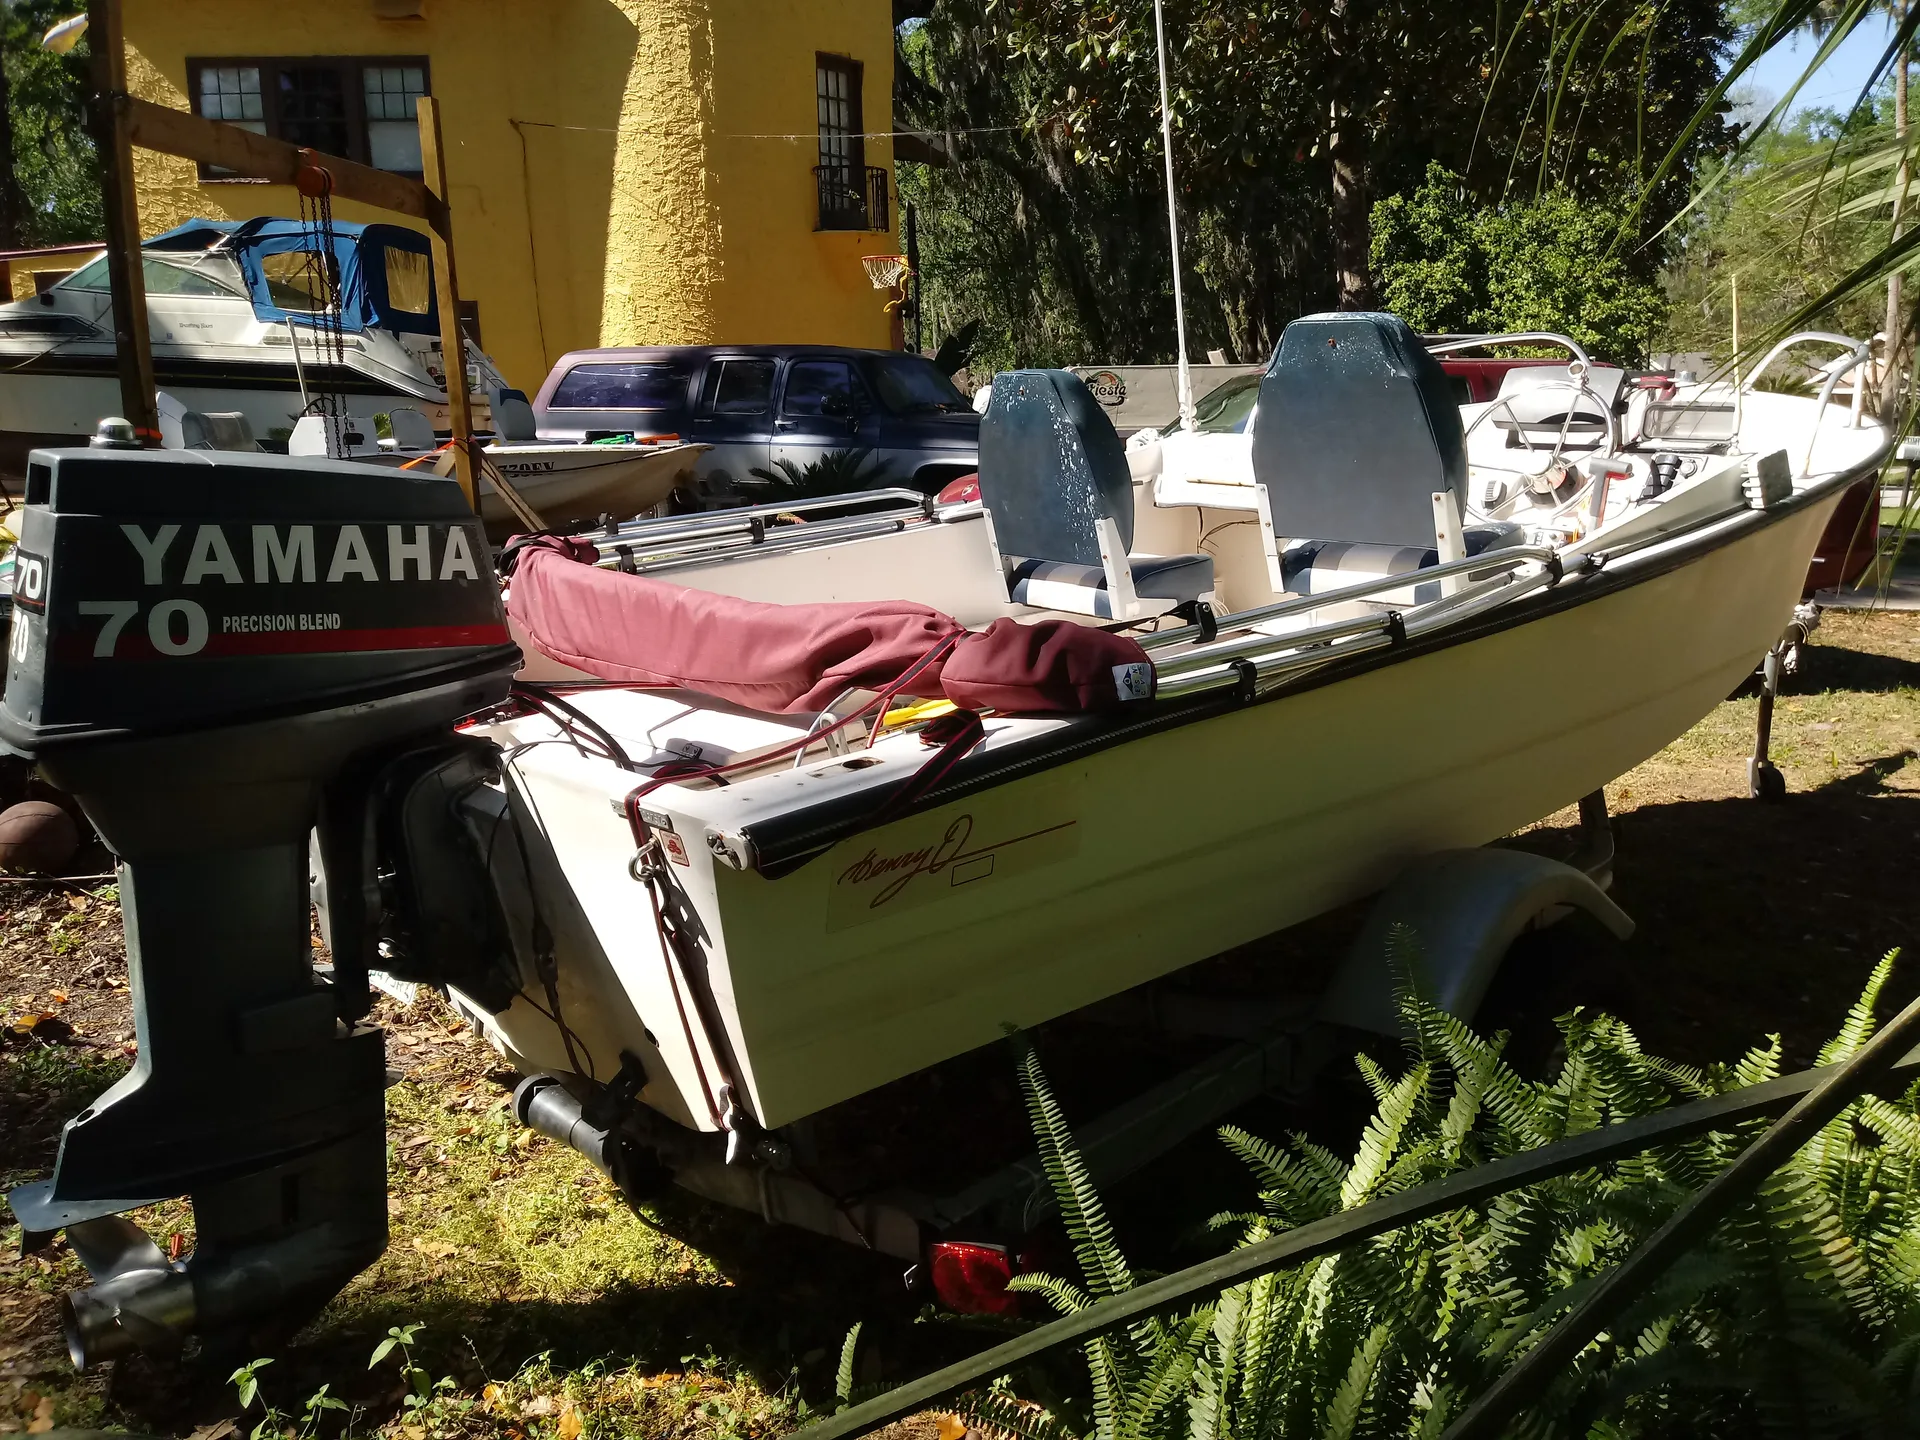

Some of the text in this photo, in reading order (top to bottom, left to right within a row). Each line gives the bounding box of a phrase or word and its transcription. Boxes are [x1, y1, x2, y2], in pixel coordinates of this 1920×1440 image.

[16, 555, 43, 600] 70
[119, 524, 480, 585] YAMAHA
[11, 609, 29, 664] 70
[78, 599, 341, 658] 70 PRECISION BLEND
[837, 847, 935, 909] Henry
